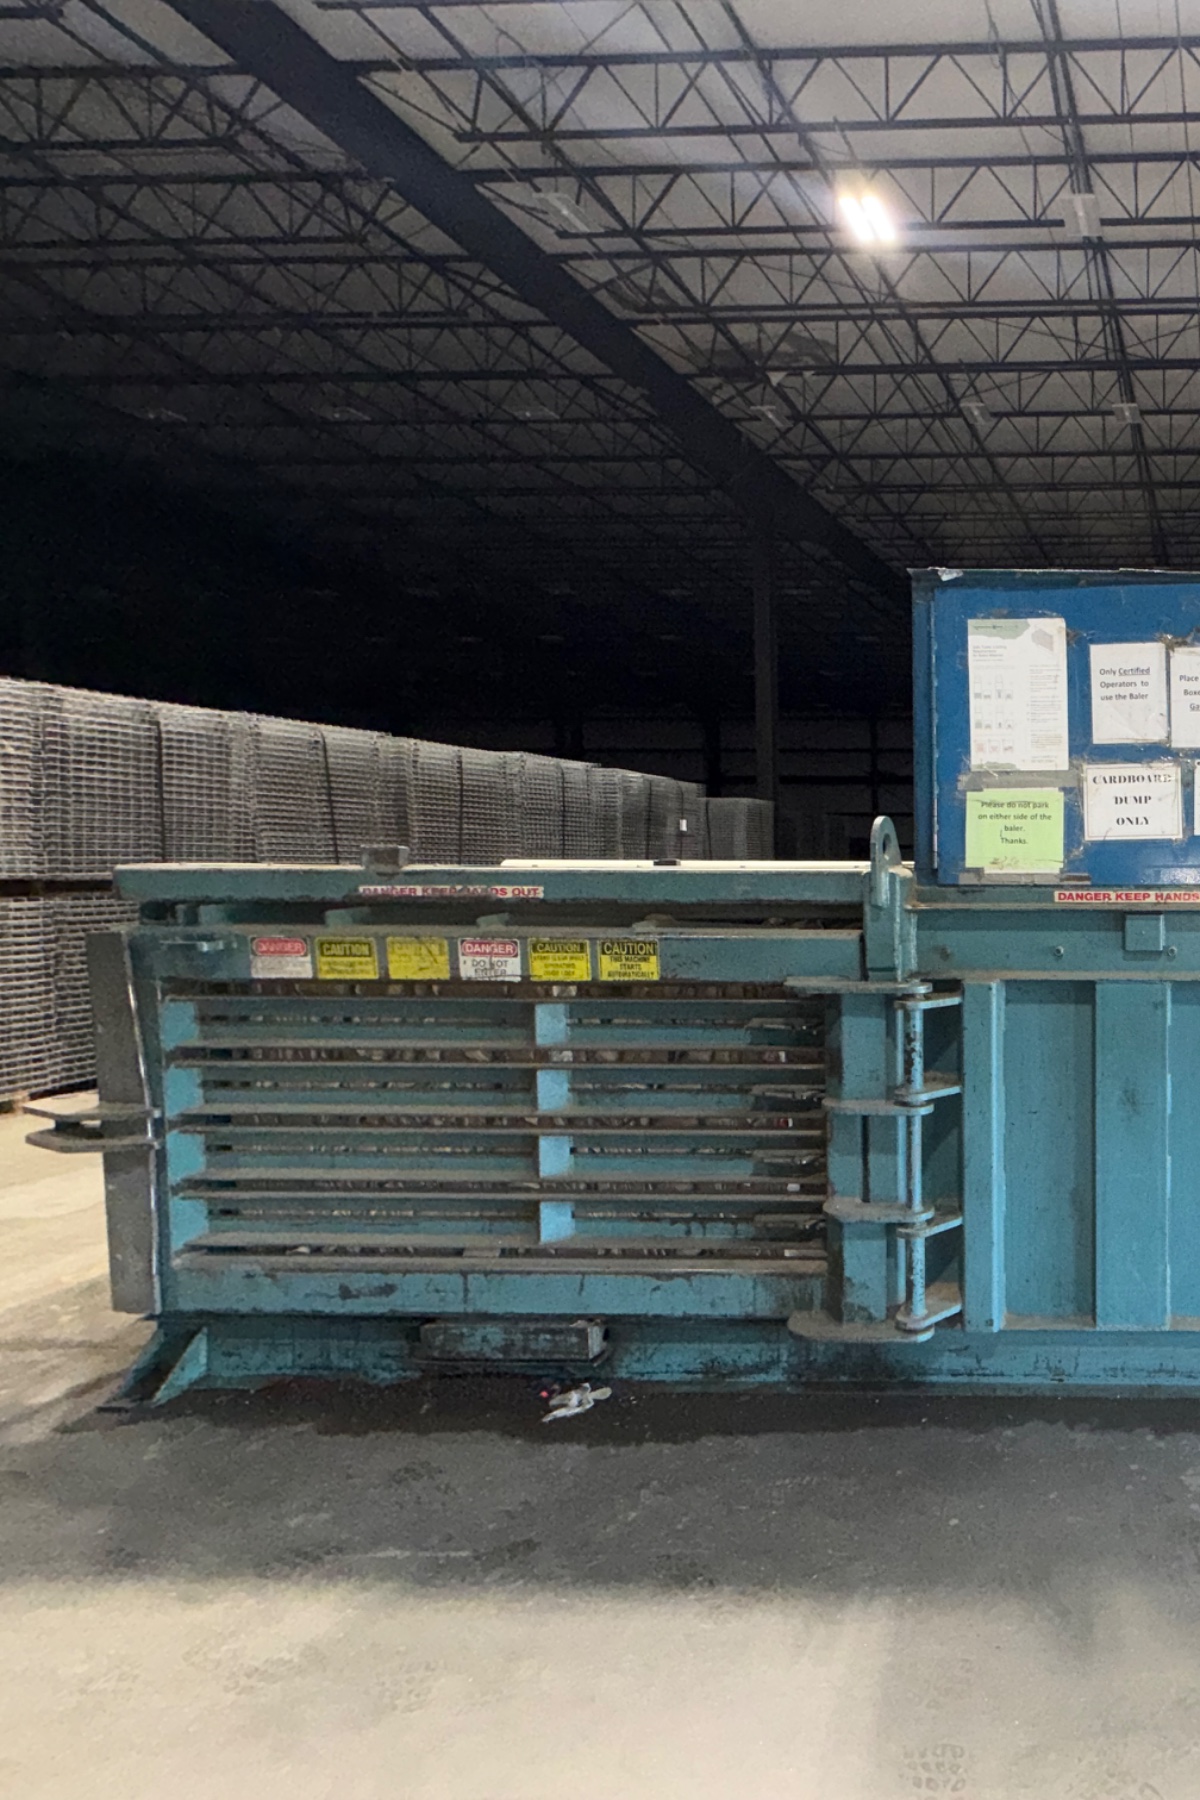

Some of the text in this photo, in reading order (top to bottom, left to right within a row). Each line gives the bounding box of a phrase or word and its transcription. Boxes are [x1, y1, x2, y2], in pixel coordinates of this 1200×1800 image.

[1099, 667, 1150, 676] Only Certified
[1179, 674, 1199, 682] Place
[1100, 681, 1137, 689] Operators
[1092, 774, 1172, 785] CARDBOARD
[1113, 795, 1152, 805] DUMP
[1032, 801, 1049, 809] park
[1116, 816, 1150, 825] ONLY
[362, 887, 417, 896] DANGER
[511, 887, 540, 897] OUT
[1057, 892, 1112, 901] DANGER
[1115, 892, 1150, 901] KEEP
[1155, 892, 1200, 901] HANDS
[258, 942, 303, 952] DANGER
[322, 943, 370, 955] CAUTION
[465, 943, 514, 954] DANGER
[536, 943, 580, 952] CAUTION
[603, 942, 655, 955] CAUTION
[472, 960, 486, 968] DO
